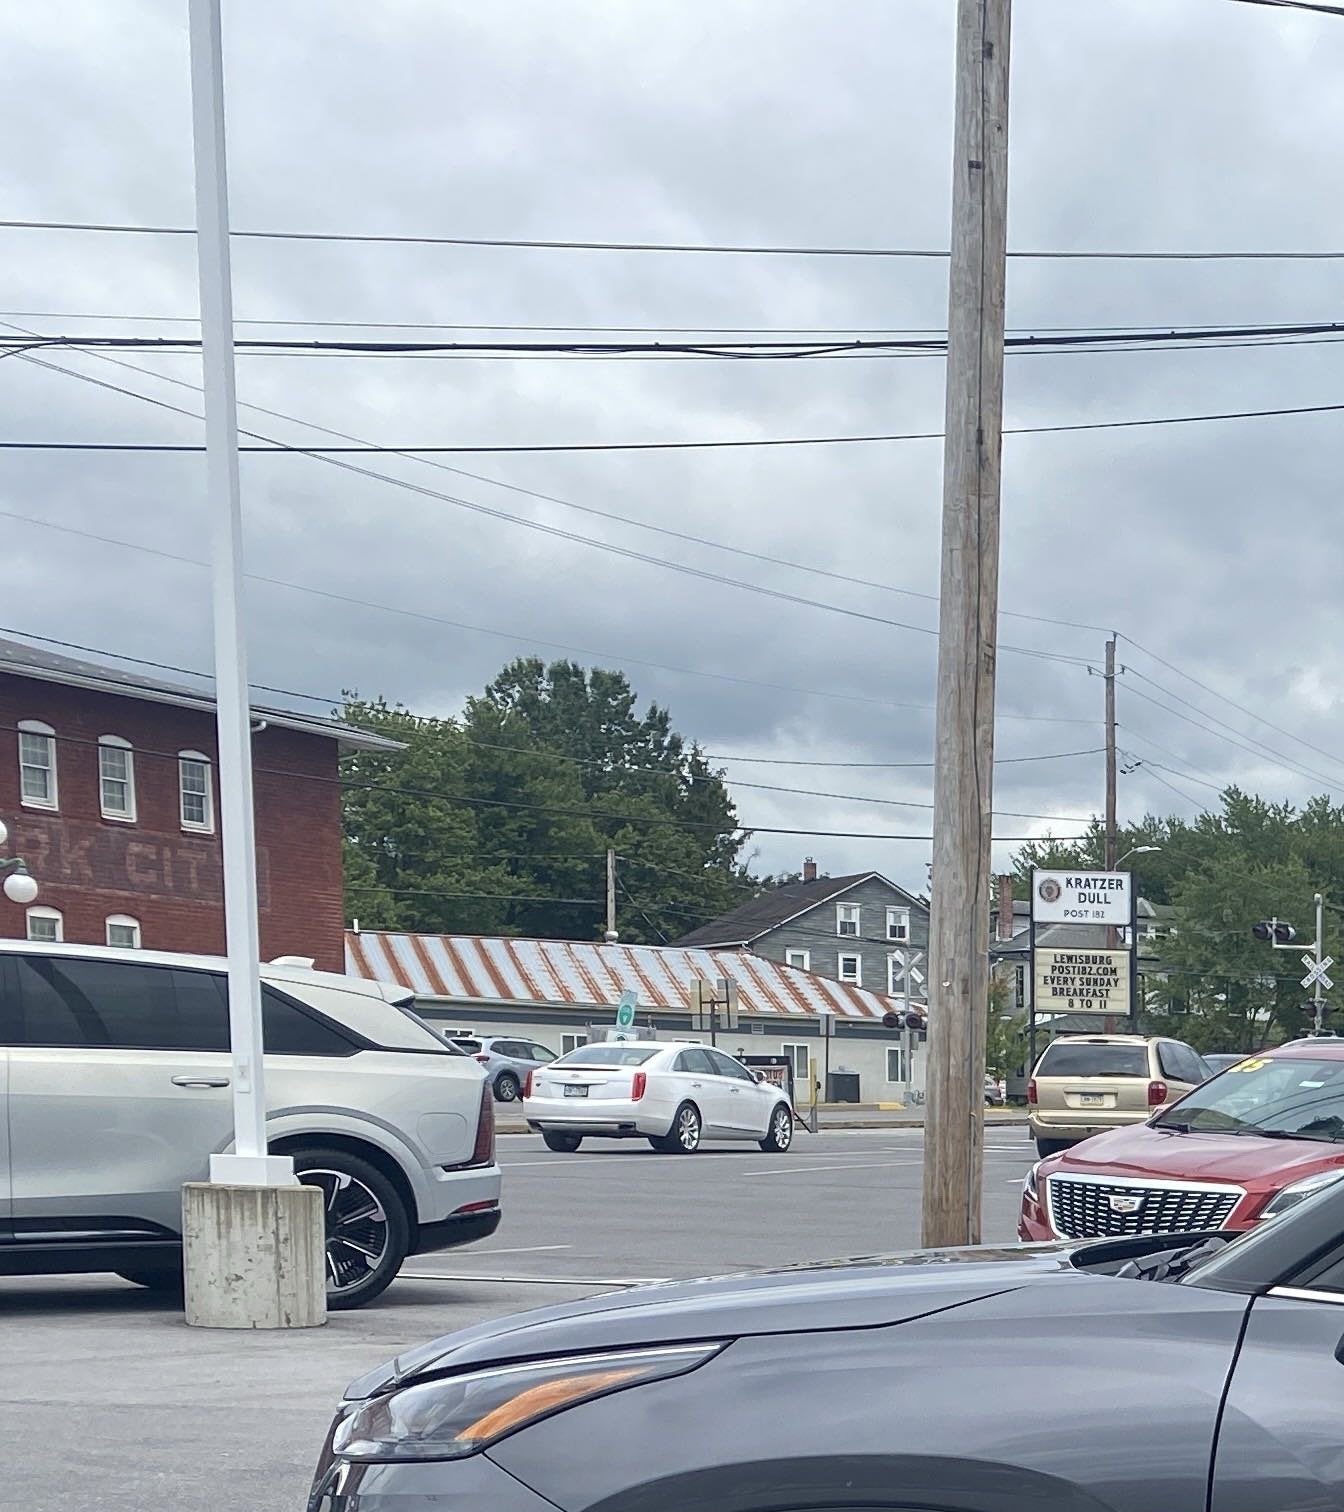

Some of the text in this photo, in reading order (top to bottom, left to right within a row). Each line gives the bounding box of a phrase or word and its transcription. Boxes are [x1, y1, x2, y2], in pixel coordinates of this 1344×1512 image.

[8, 825, 224, 892] RK CIT
[1065, 877, 1124, 890] KRATZER
[1078, 892, 1112, 904] DULL
[1063, 909, 1105, 919] POST 182
[1053, 953, 1113, 965] LEWISBURG
[1051, 965, 1117, 976] POST182.COM
[1043, 976, 1120, 988] EVERY SUNDAY
[1051, 987, 1110, 998] BREAKFAST
[1068, 998, 1107, 1009] 8 TO 11
